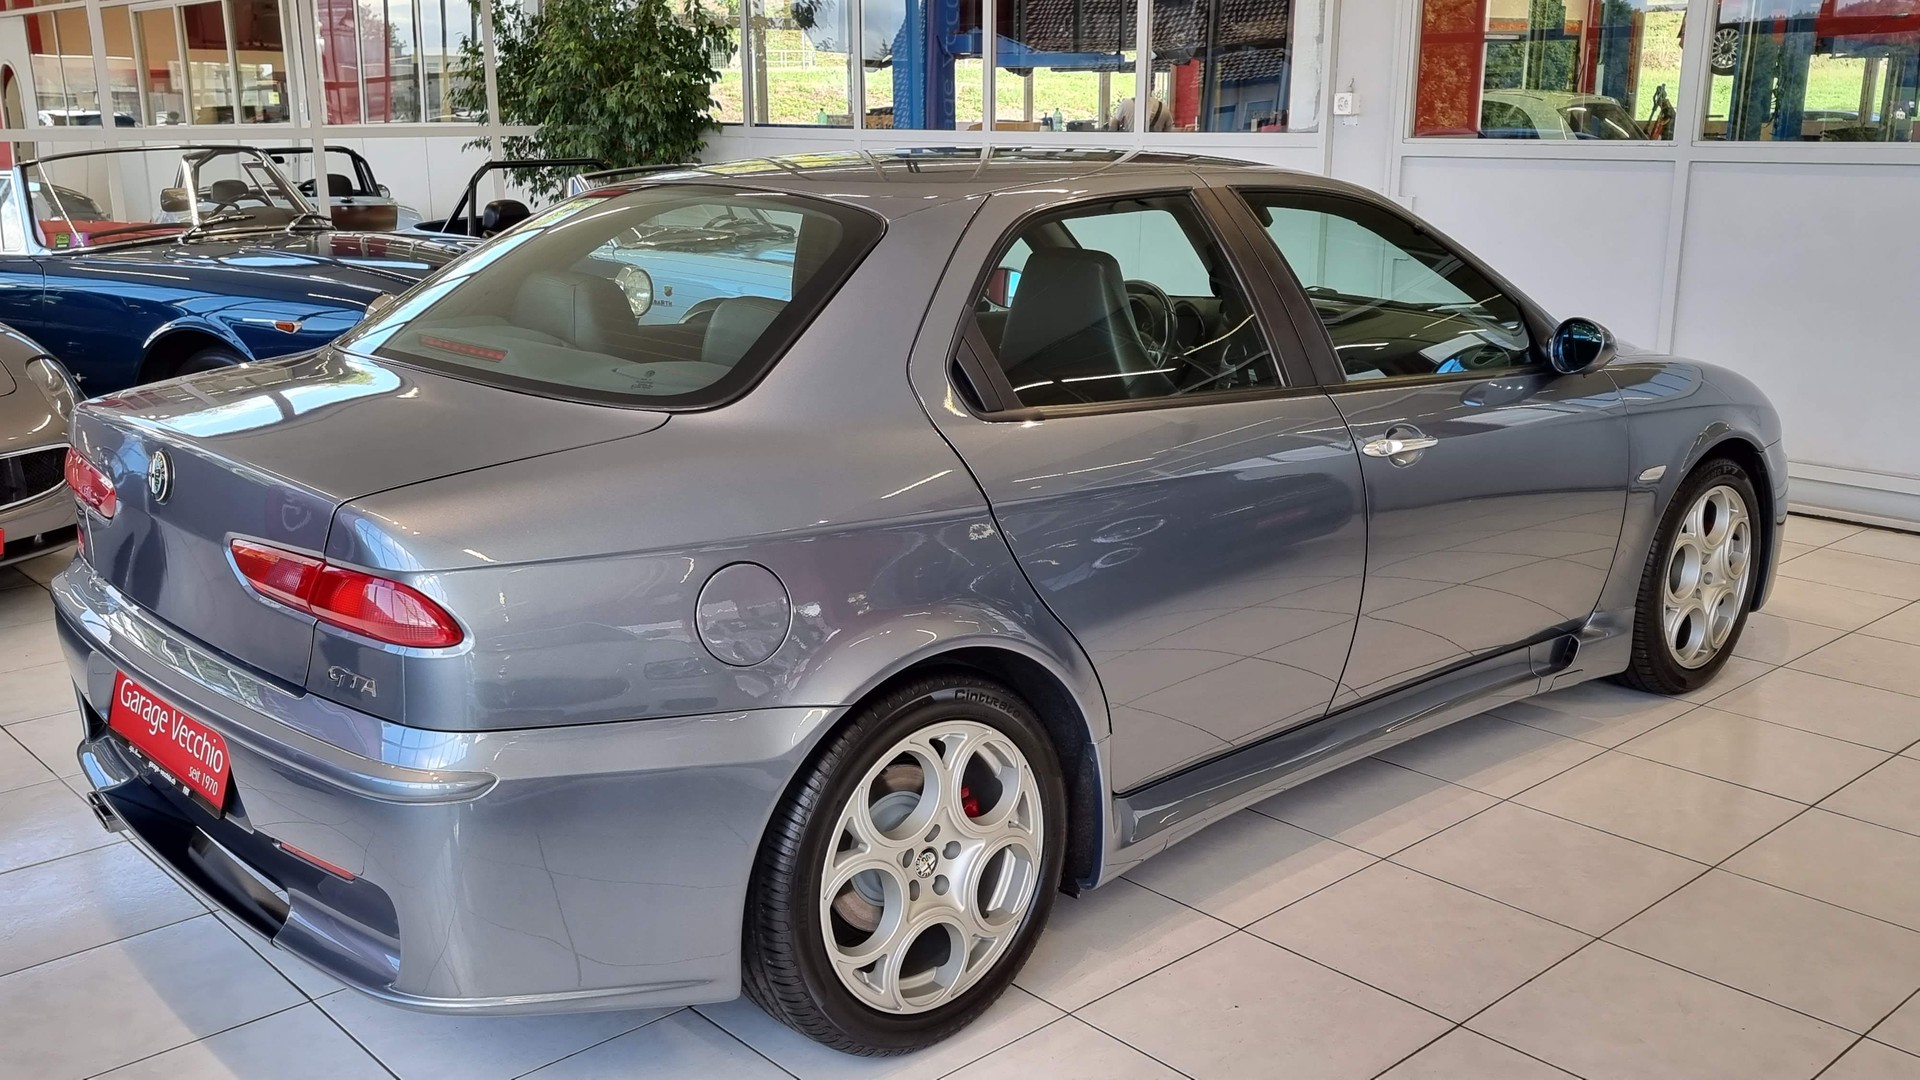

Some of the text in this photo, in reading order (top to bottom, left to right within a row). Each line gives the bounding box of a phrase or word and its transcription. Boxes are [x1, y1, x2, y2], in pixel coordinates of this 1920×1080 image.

[328, 665, 377, 697] GTA
[954, 689, 1021, 719] Cinturato
[120, 679, 223, 773] Garage Vecchio
[188, 766, 200, 783] seit
[201, 773, 218, 796] 1970
